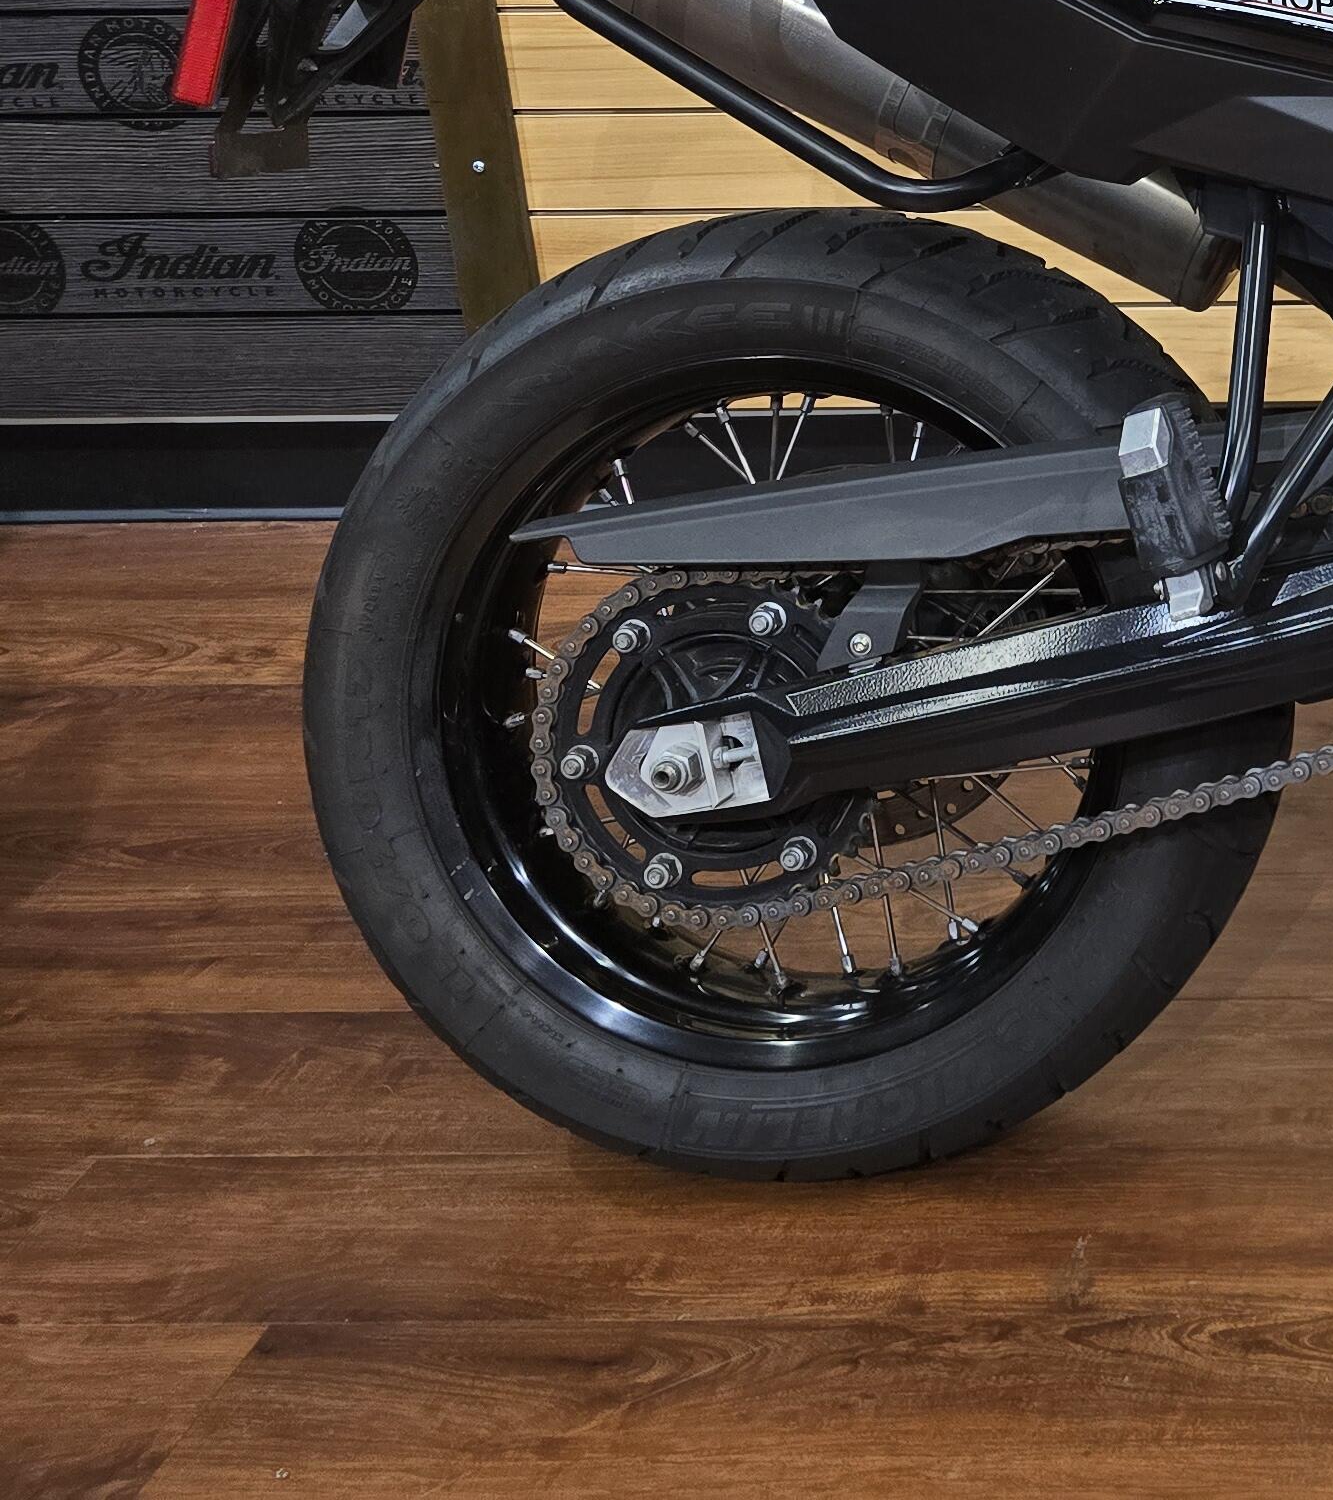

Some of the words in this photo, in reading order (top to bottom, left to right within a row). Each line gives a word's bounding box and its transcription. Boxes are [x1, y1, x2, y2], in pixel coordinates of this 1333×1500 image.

[80, 232, 276, 282] Indian
[298, 244, 412, 274] Indian
[94, 286, 275, 299] MOTORCYCLE
